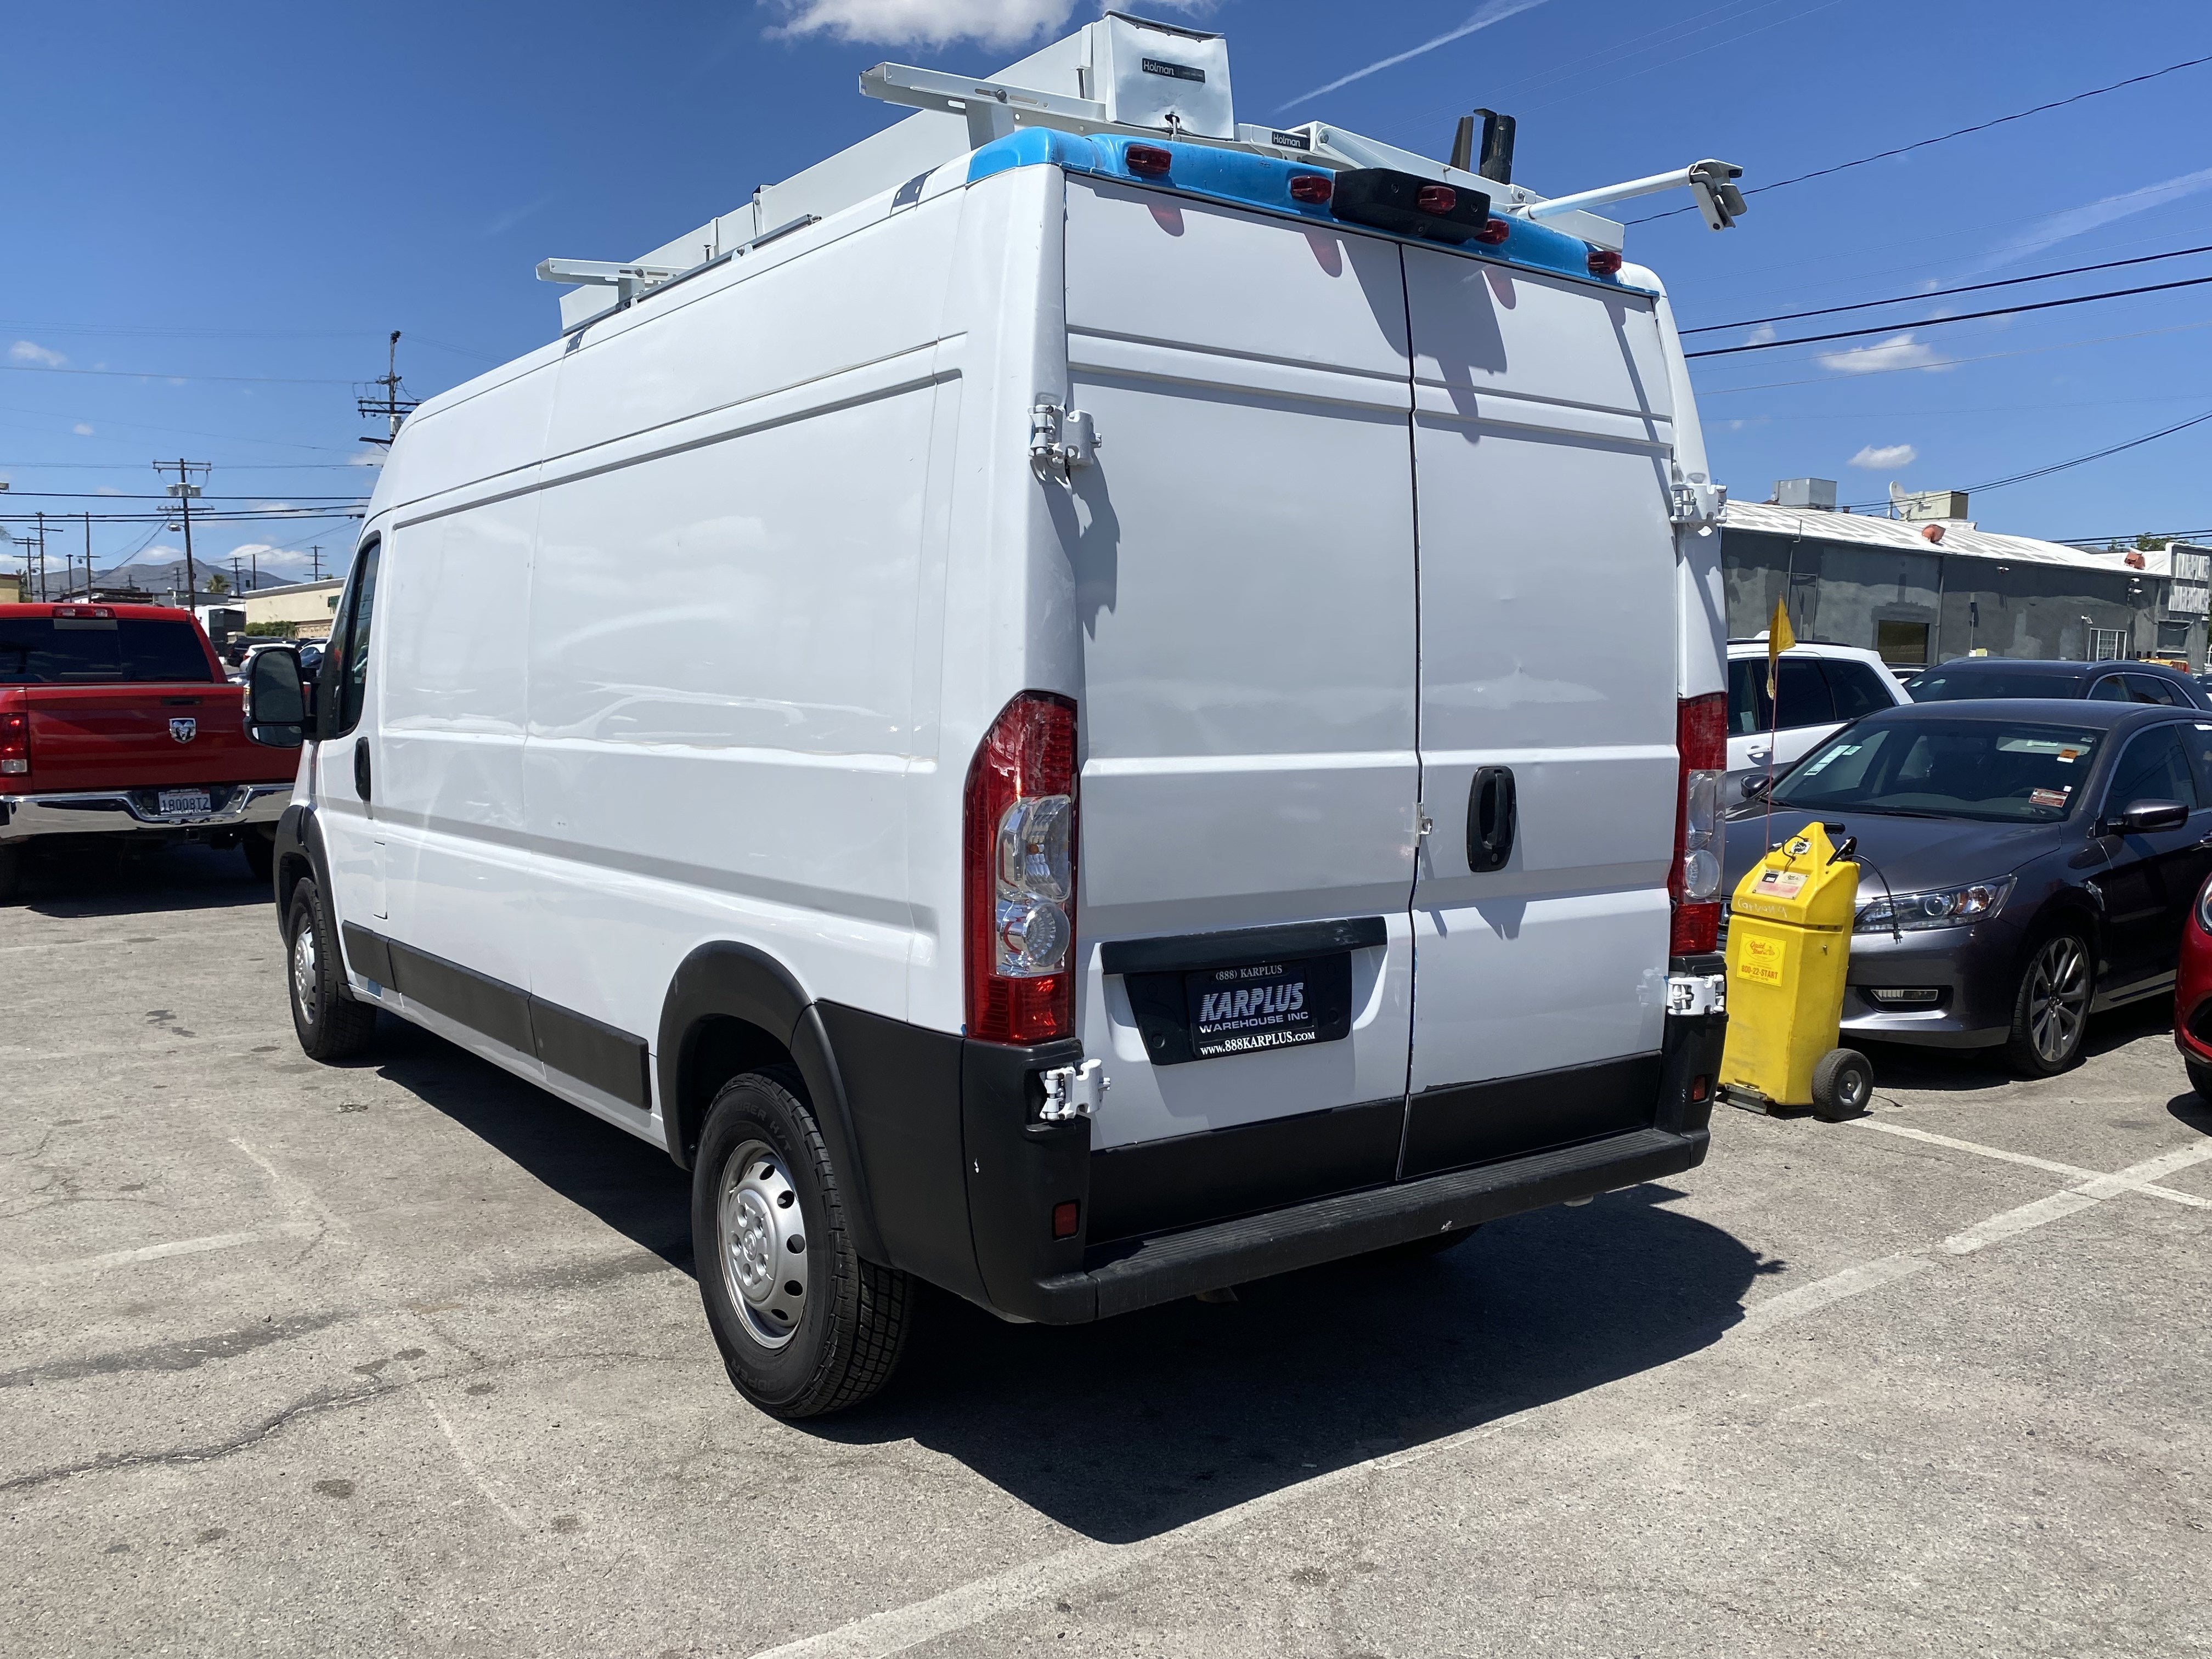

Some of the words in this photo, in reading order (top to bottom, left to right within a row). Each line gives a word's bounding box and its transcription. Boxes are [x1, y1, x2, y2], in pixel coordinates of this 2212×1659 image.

[1143, 60, 1175, 76] Holman
[1273, 133, 1301, 147] Holman
[1215, 969, 1238, 981] (888)
[1240, 964, 1283, 979] KARPLUS
[1741, 964, 1779, 980] 800-22-START
[1199, 982, 1304, 1022] KARPLUS
[1199, 1014, 1284, 1034] WAREHOUSE
[1287, 1012, 1309, 1022] INC
